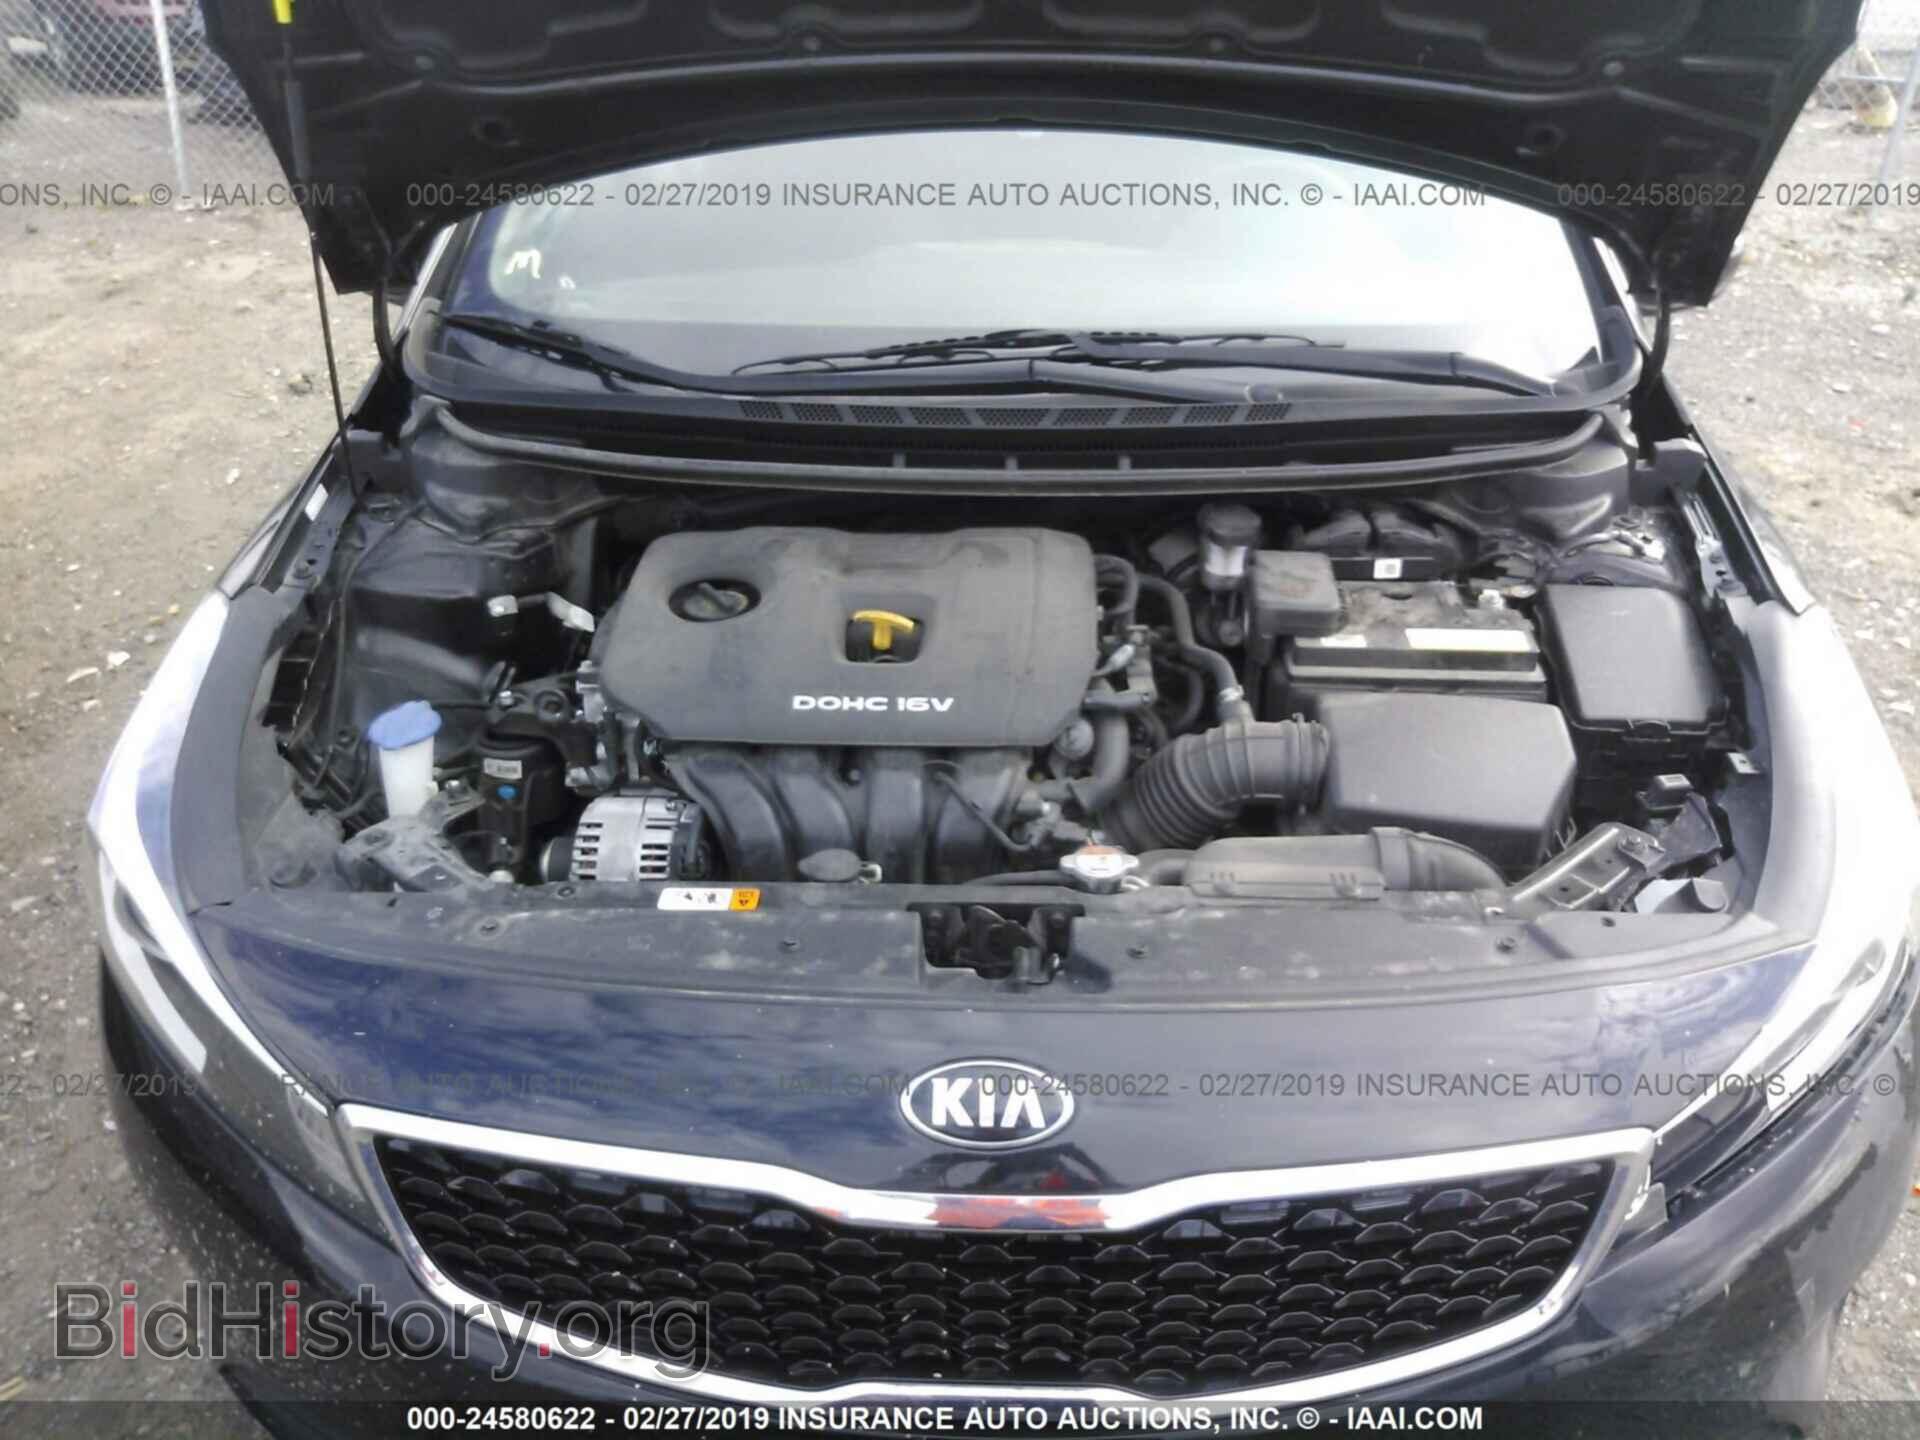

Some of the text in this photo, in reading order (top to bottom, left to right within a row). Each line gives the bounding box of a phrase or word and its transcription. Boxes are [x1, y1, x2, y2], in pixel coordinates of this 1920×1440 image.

[791, 695, 954, 712] DOHC 16V
[931, 1077, 1046, 1128] KIA
